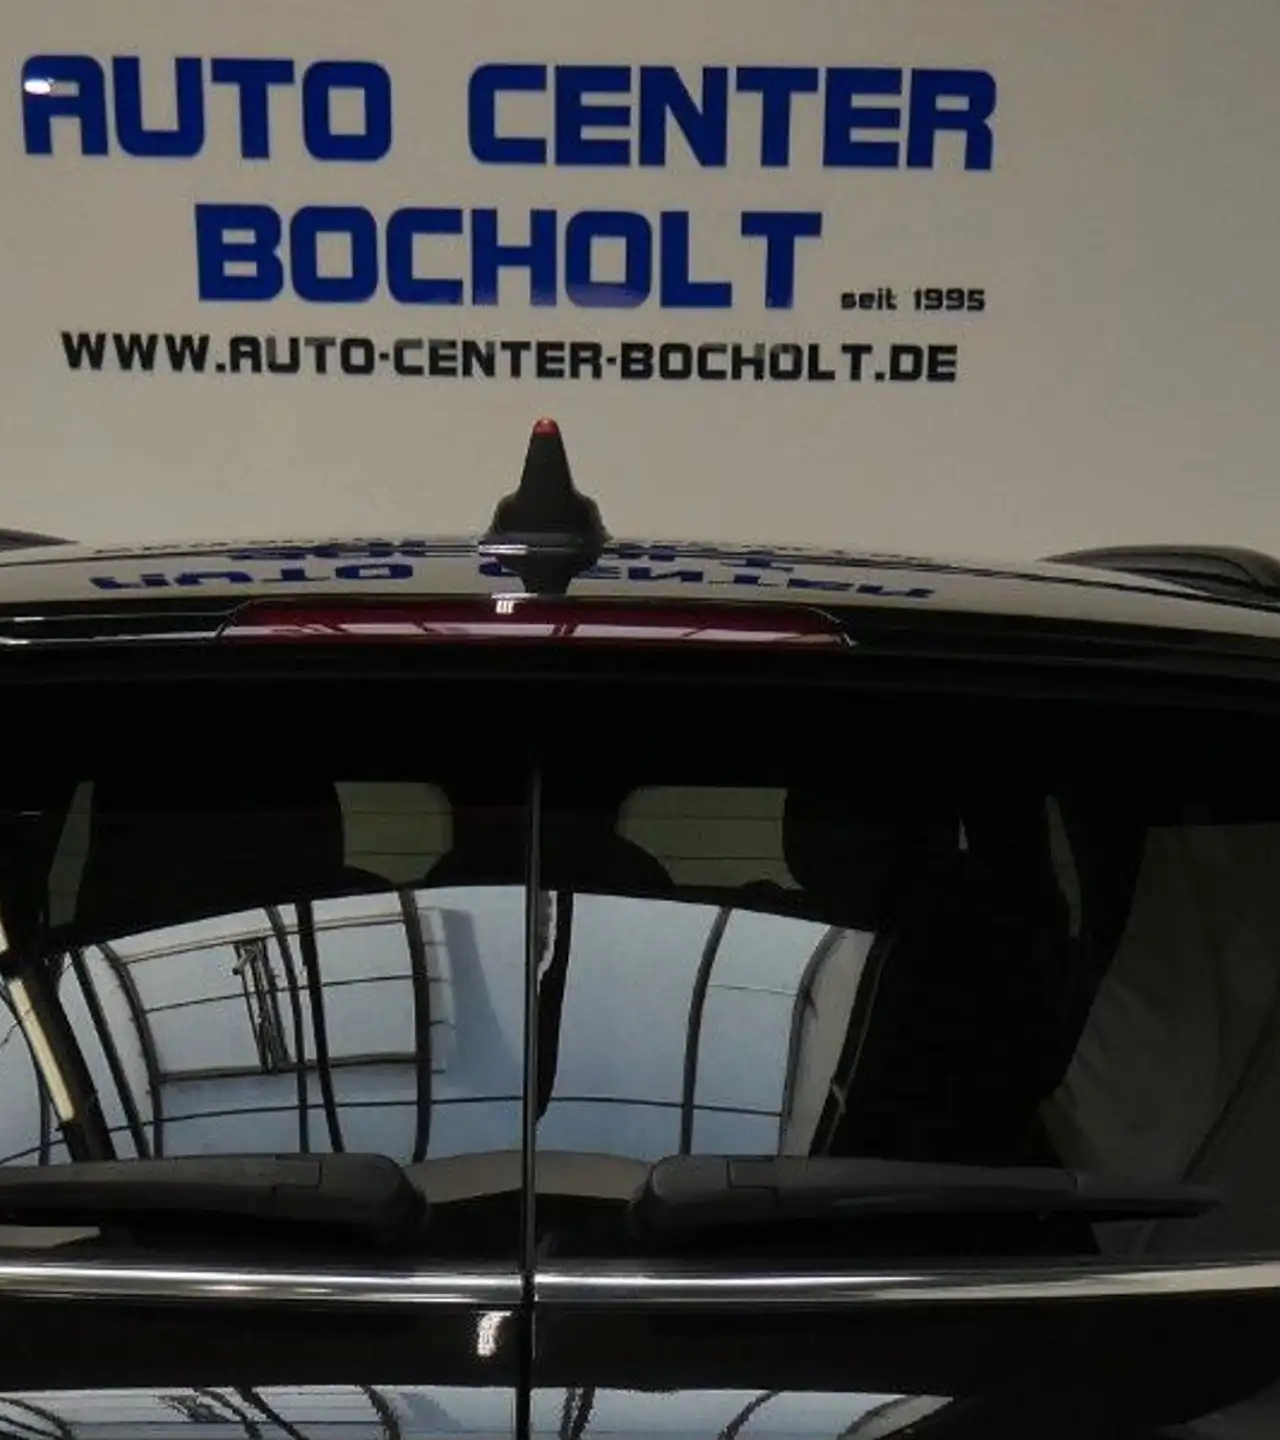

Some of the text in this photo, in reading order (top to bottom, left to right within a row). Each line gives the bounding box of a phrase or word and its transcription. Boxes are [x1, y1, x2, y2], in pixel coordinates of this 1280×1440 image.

[22, 54, 998, 172] AUTO CENTER
[195, 202, 822, 311] BOCHOLT
[840, 287, 986, 312] seit 1995
[61, 330, 958, 383] WWW.AUTO-CENTER-BOCHOLT.DE
